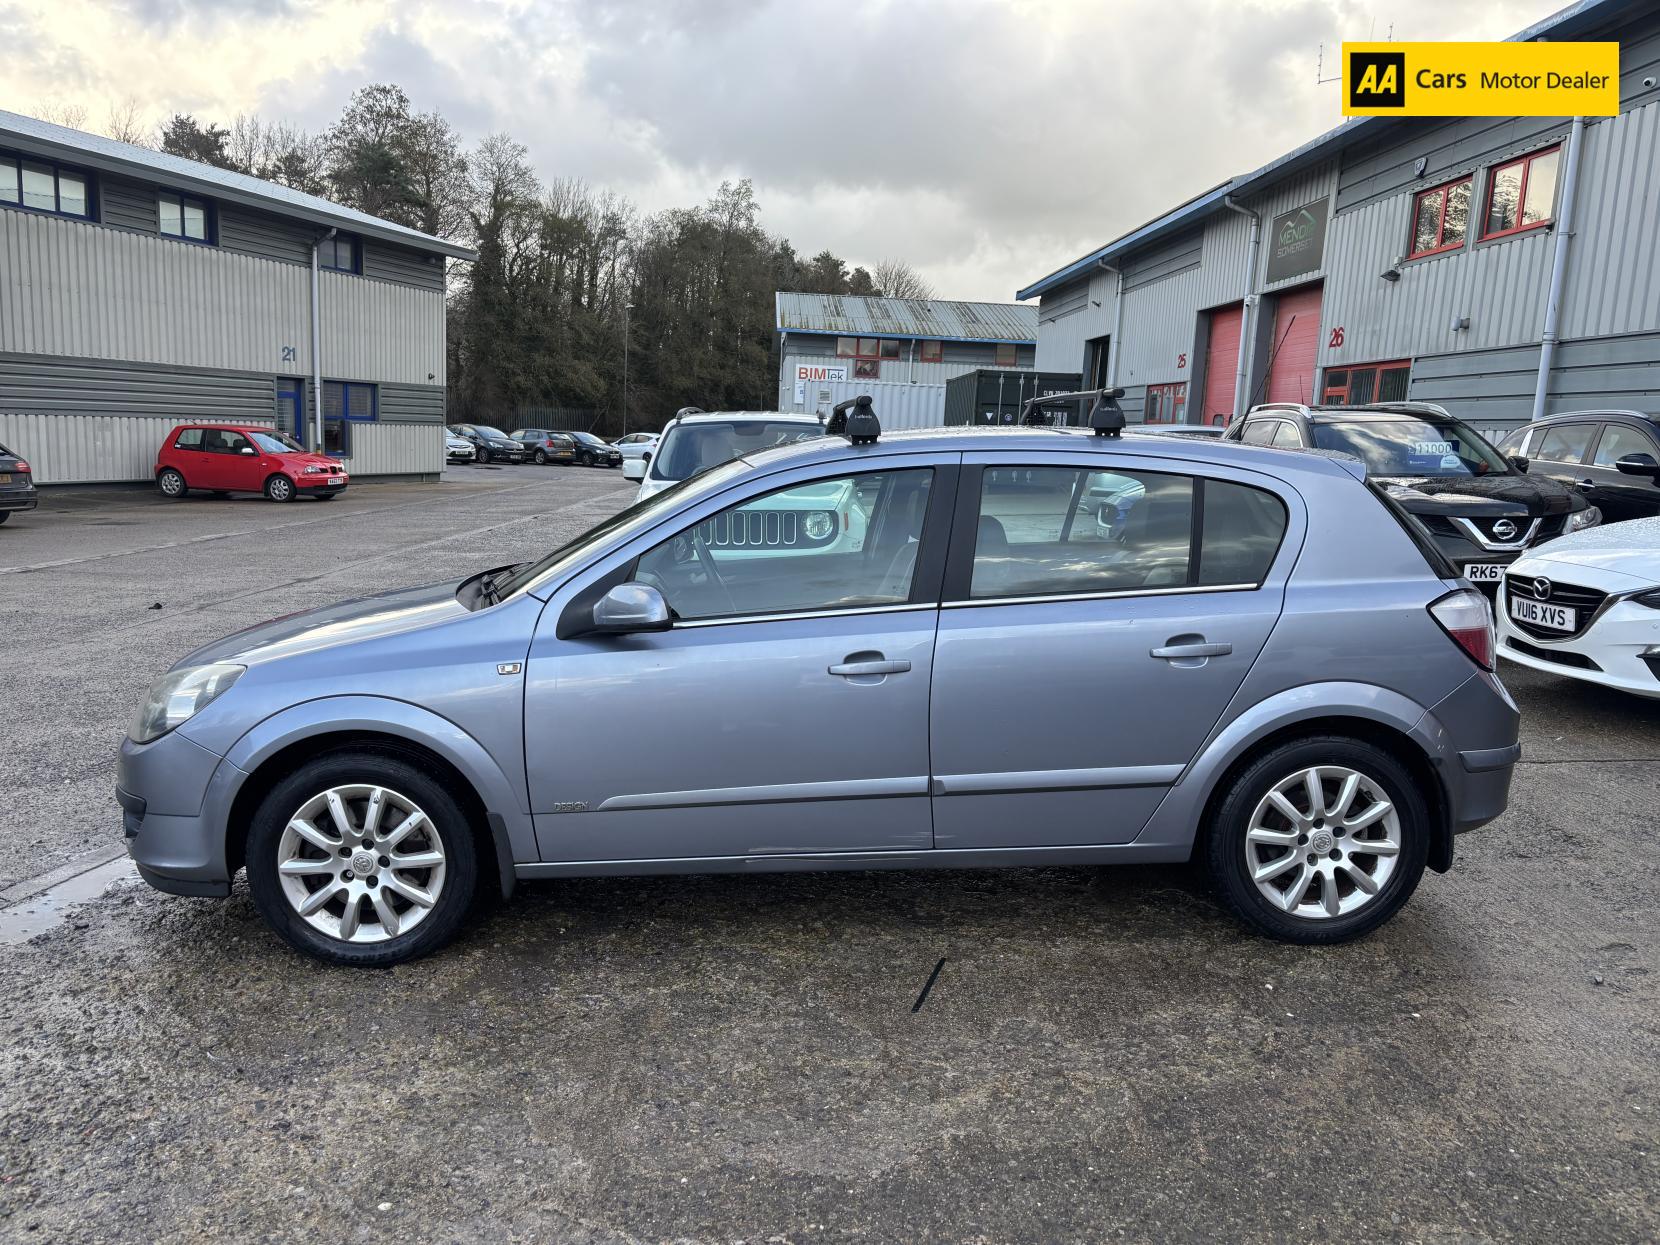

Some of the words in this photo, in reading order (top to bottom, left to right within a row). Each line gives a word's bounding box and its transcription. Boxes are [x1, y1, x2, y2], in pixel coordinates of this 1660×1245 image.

[1328, 326, 1345, 348] 26
[281, 346, 296, 361] 21
[1177, 353, 1187, 369] 25
[1516, 600, 1538, 620] VU16
[1540, 603, 1566, 626] XVS
